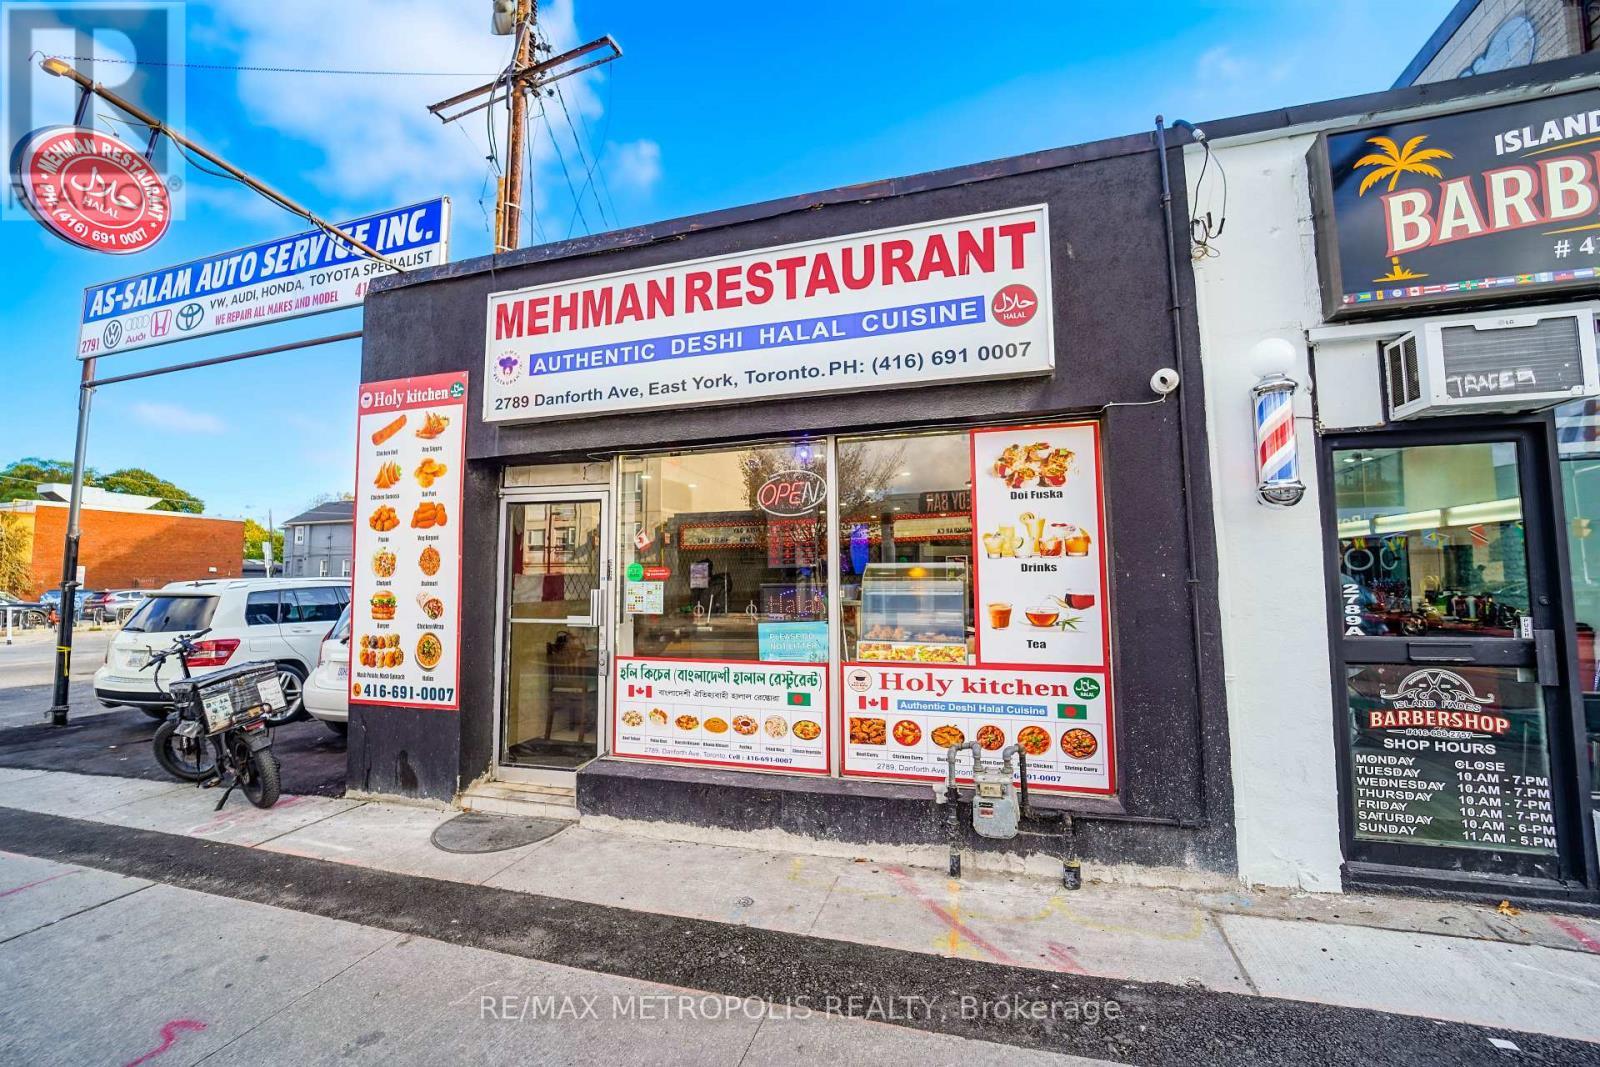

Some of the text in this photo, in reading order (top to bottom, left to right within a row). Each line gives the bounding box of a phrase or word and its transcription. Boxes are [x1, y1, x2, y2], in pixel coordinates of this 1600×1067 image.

[1495, 110, 1600, 155] ISLAND
[37, 138, 164, 222] MEHMAN RESTAURANT
[83, 197, 120, 219] HALAL
[1381, 152, 1600, 257] BARB
[52, 208, 89, 238] (416)
[92, 230, 117, 245] 691
[120, 228, 149, 245] 0007
[89, 209, 433, 318] AS-SALAM AUTO SERVICE INC.
[262, 280, 305, 298] HONDA,
[310, 268, 360, 287] TOYOTA
[495, 220, 1036, 340] MEHMAN RESTAURANT
[215, 315, 226, 326] WE
[226, 308, 252, 324] REPAIR
[253, 307, 266, 318] ALL
[267, 301, 293, 315] MAKES
[294, 296, 311, 310] AND
[312, 291, 339, 306] MODEL
[1003, 311, 1028, 320] HALAL
[125, 332, 147, 345] Audi
[533, 301, 978, 374] AUTHENTIC DESHI HALAL CUISINE
[495, 395, 529, 411] 2789
[534, 384, 604, 407] Danforth
[607, 381, 644, 400] Ave,
[648, 375, 687, 396] East
[692, 373, 738, 392] York,
[872, 351, 924, 376] (416)
[931, 348, 969, 367] 691
[978, 341, 1032, 361] 0007
[374, 389, 405, 408] Holy
[406, 387, 449, 404] kitchen
[761, 480, 821, 506] OPEN
[1010, 490, 1063, 500] Doi Fuska
[1021, 563, 1057, 572] Drinks
[1026, 639, 1047, 649] Tea
[364, 684, 454, 702] 416-691-0007
[879, 672, 954, 696] Holy
[962, 677, 1069, 697] kitchen
[900, 701, 1046, 715] Authentic Deshi Halal Cuisine
[1393, 699, 1482, 713] ISLAND FADES
[1370, 710, 1511, 735] BARBERSHOP
[1384, 738, 1497, 755] SHOP HOURS
[899, 764, 930, 773] Danforth
[1356, 754, 1506, 772] MONDAY CLOSE
[1356, 765, 1421, 778] TUESDAY
[1456, 772, 1499, 783] 10.AM
[1356, 777, 1446, 791] WEDNESDAY
[1457, 784, 1500, 795] 10.AM
[1357, 788, 1433, 801] THURSDAY
[1458, 795, 1501, 807] 10.AM
[1357, 800, 1408, 811] FRIDAY
[1459, 807, 1503, 819] 10.AM
[1358, 811, 1433, 825] SATURDAY
[1461, 819, 1505, 831] 10.AM
[1358, 822, 1418, 835] SUNDAY
[1462, 831, 1506, 843] 11.AM
